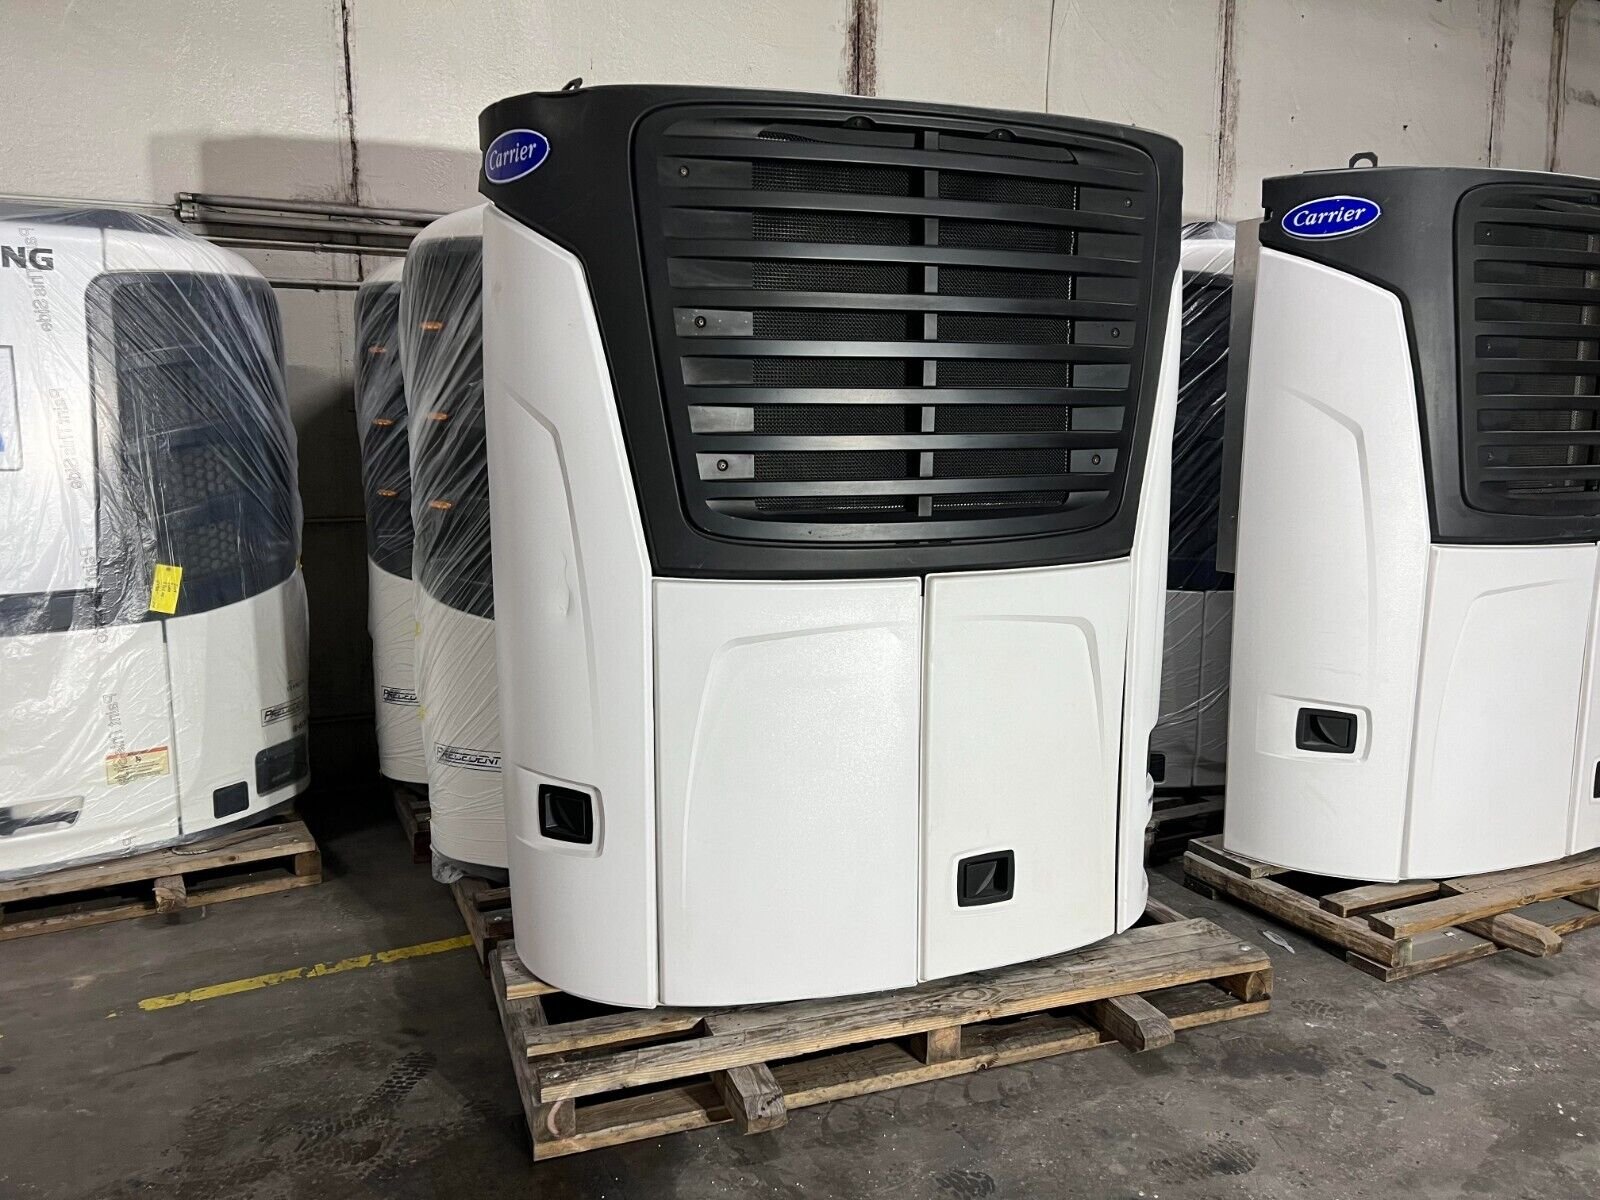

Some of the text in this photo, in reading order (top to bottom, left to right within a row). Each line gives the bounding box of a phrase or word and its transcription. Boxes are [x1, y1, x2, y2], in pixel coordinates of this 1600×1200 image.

[489, 142, 537, 171] Carrier
[1293, 206, 1366, 227] Carrier
[1, 245, 54, 270] NG
